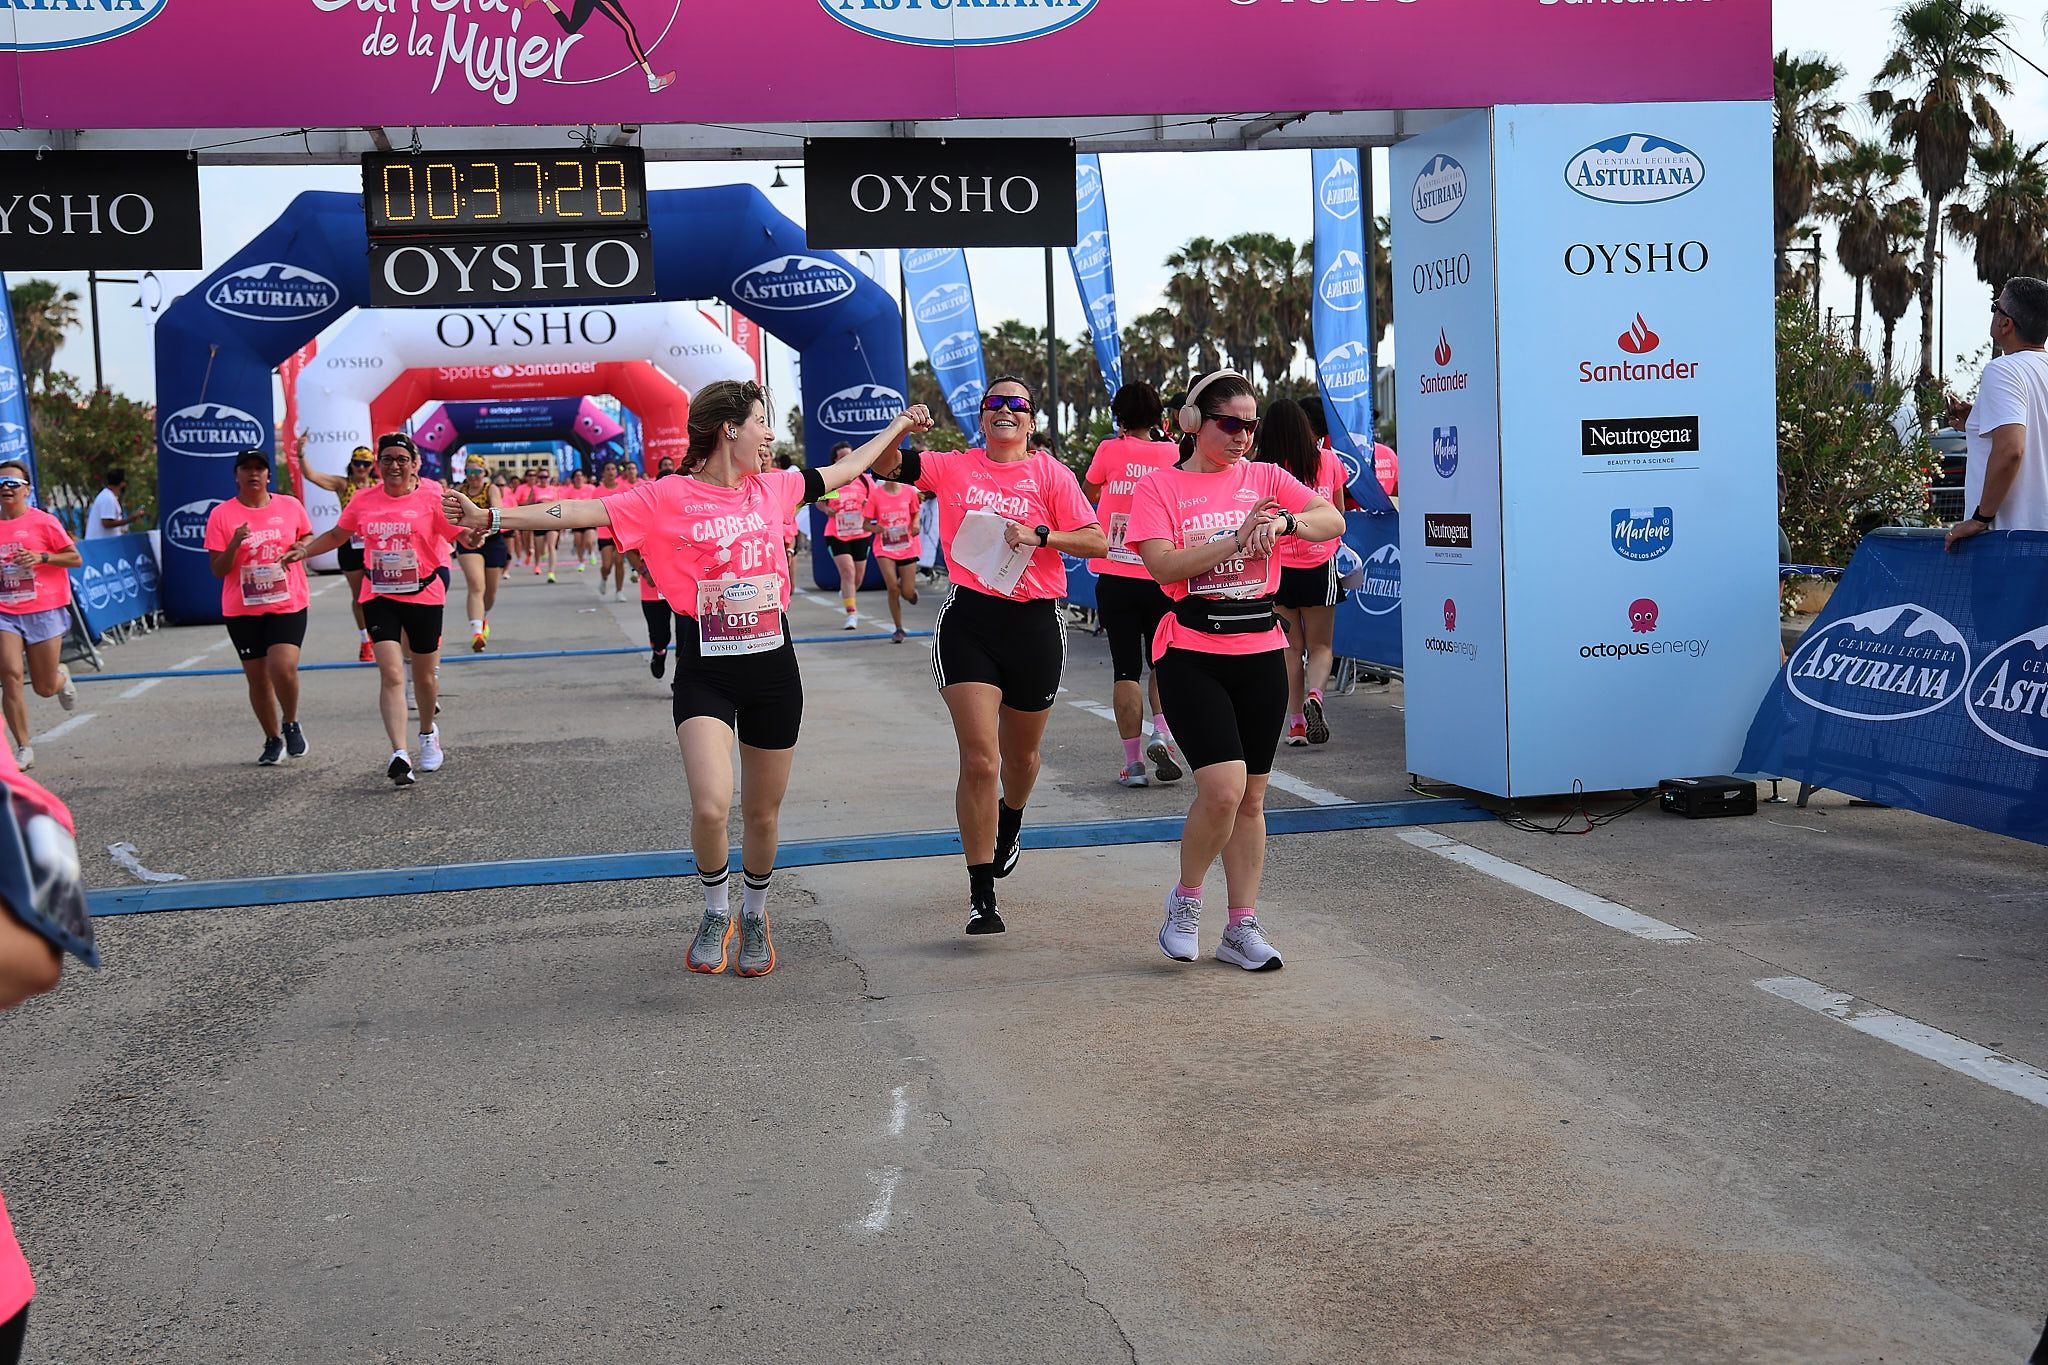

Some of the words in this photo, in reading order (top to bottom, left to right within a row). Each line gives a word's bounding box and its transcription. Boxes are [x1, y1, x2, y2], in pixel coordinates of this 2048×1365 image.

[362, 17, 399, 56] de
[408, 15, 434, 57] la
[431, 9, 584, 104] Mujer
[1575, 159, 1695, 187] ASTURIANA
[1596, 157, 1640, 166] CENTRAL
[1645, 156, 1691, 164] LECHERA
[383, 161, 626, 220] 00:37:28
[850, 173, 1039, 214] OYSHO
[1416, 181, 1463, 211] ASTURIANA
[383, 239, 640, 296] OYSHO
[1564, 241, 1709, 275] OYSHO
[1413, 253, 1470, 295] OYSHO
[215, 283, 329, 307] ASTURIANA
[744, 277, 849, 299] ASTURIANA
[436, 309, 617, 349] OYSHO
[326, 356, 384, 370] OYSHO
[670, 344, 723, 357] OYSHO
[438, 367, 491, 382] Sports
[514, 361, 598, 378] Santander
[1420, 369, 1468, 395] Santander
[1578, 358, 1698, 383] Santander
[825, 405, 902, 423] ASTURIAN
[168, 423, 259, 445] ASTURIANA
[1589, 426, 1692, 449] Neutrogena
[965, 485, 1028, 518] CARRERA
[693, 511, 767, 543] CARRERA
[1427, 520, 1468, 544] Neutrogena
[1615, 519, 1670, 548] Marlene
[1618, 547, 1630, 557] HIJA
[1650, 545, 1666, 558] ALPES
[383, 570, 402, 578] 016
[1214, 560, 1244, 574] 016
[728, 613, 758, 627] 016
[710, 644, 738, 652] OYSHO
[753, 640, 776, 649] Santander
[1839, 638, 1896, 656] CENTRAL
[1899, 646, 1956, 663] LECHERA
[1794, 637, 1950, 701] ASTURIANA
